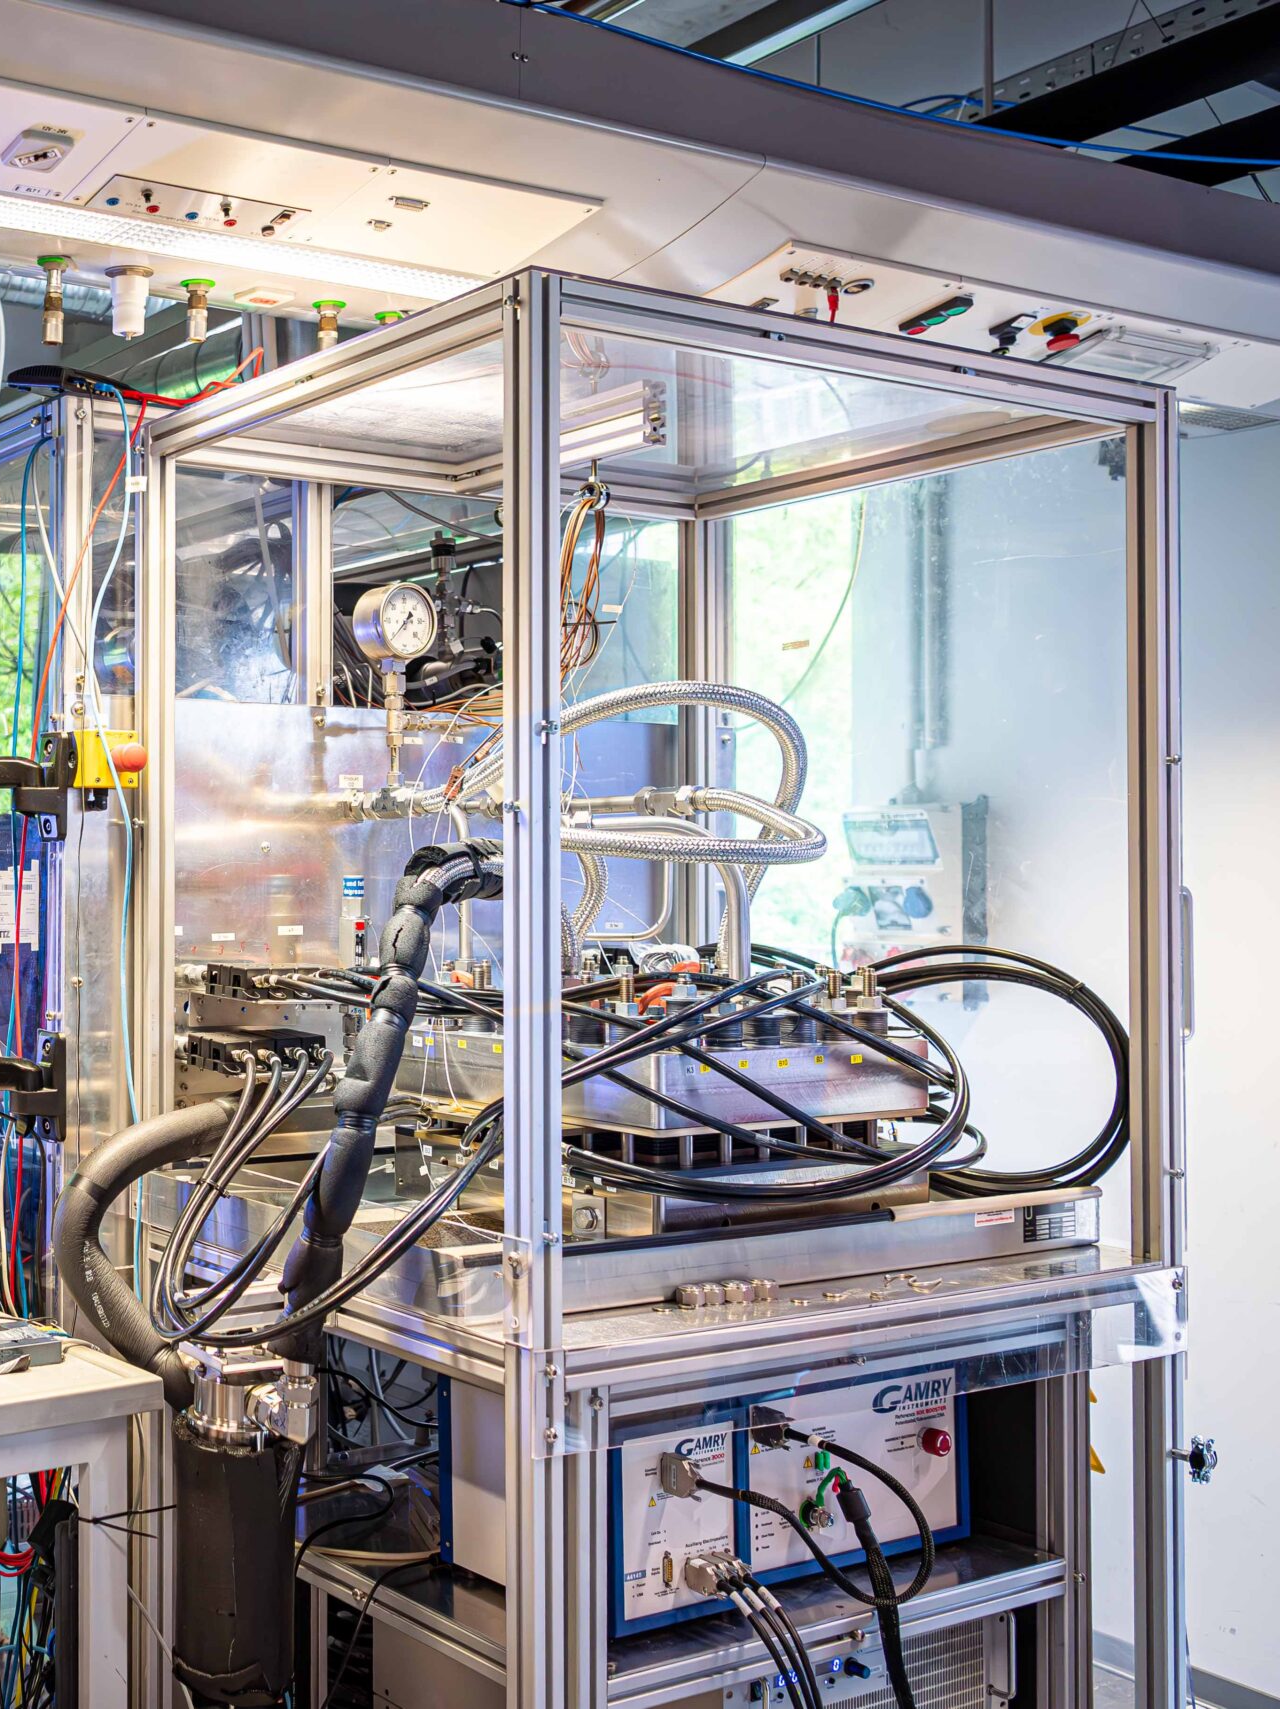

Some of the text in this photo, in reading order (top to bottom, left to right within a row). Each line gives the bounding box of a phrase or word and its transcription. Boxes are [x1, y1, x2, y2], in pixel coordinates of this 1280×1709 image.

[872, 1377, 952, 1413] GAMRY
[898, 1397, 947, 1411] INSTRUMENTS
[675, 1433, 727, 1456] GAMRY
[833, 1659, 840, 1671] 0
